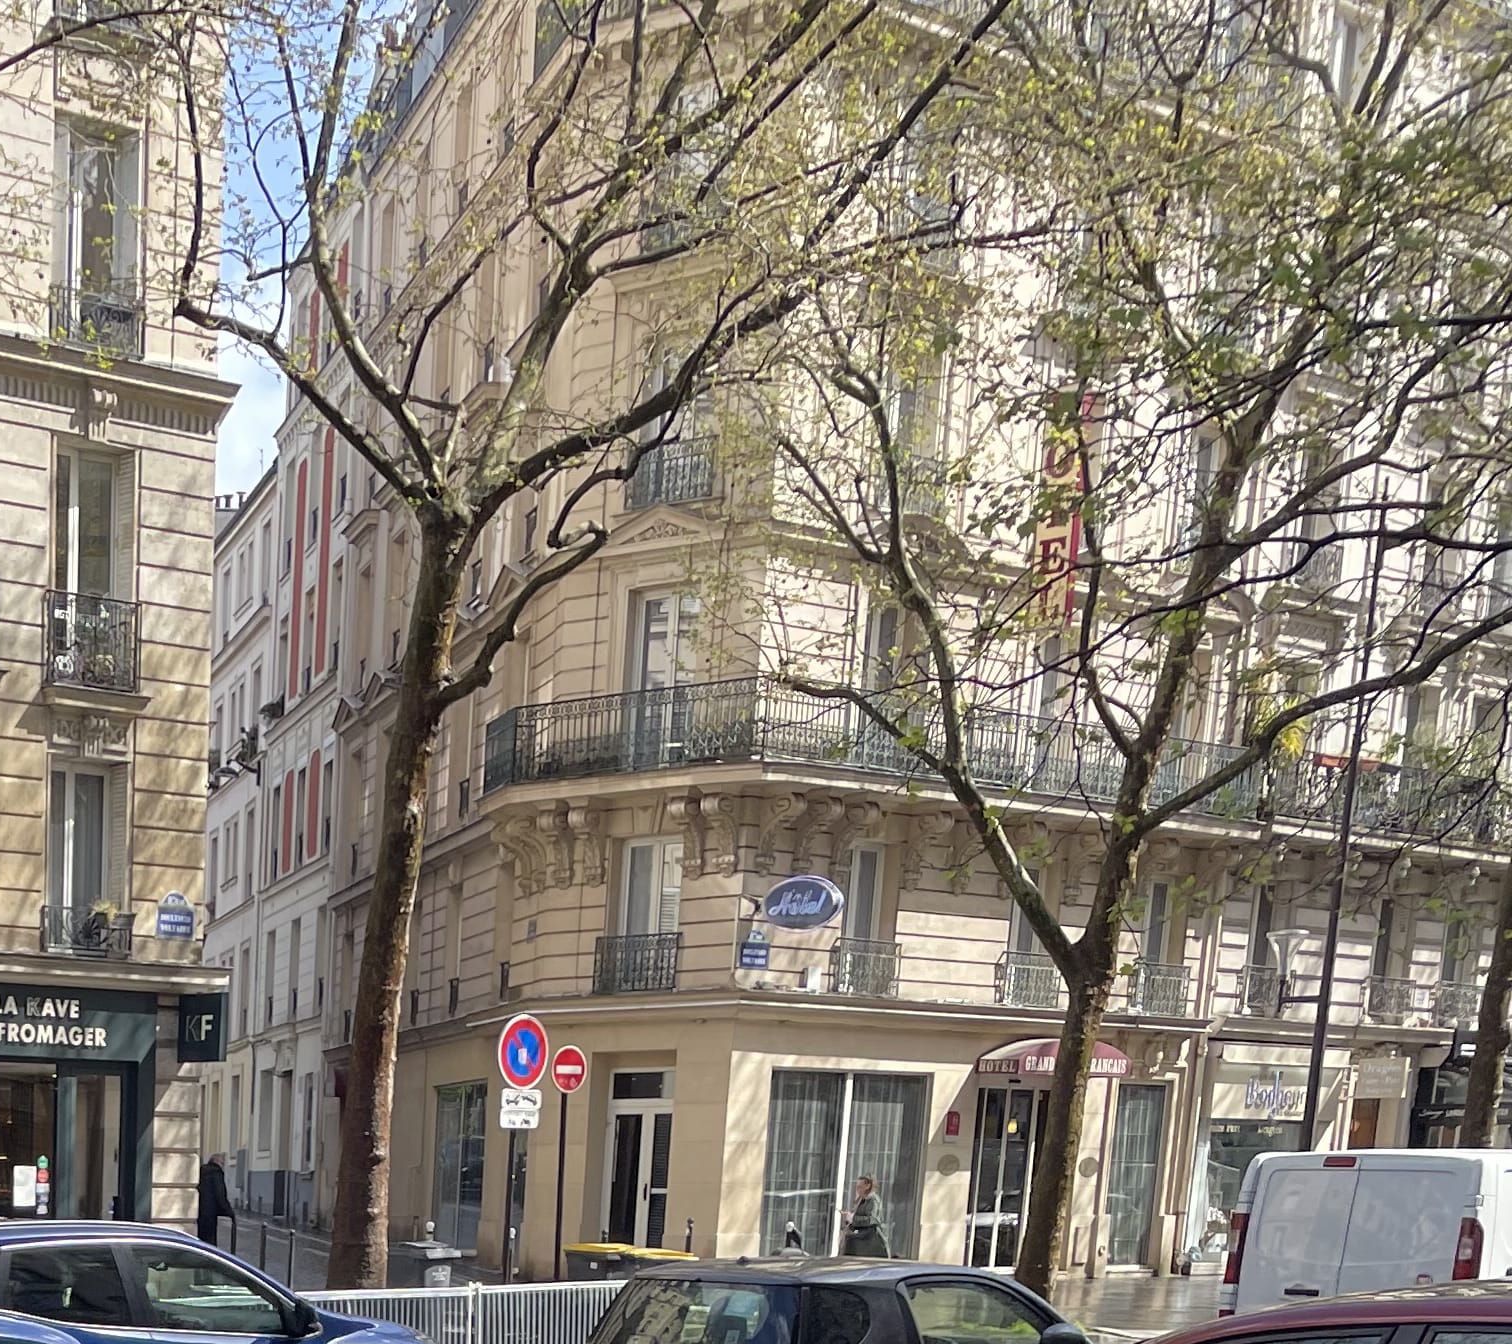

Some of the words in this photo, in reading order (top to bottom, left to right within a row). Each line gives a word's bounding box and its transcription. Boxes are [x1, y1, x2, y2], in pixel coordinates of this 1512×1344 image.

[26, 997, 80, 1019] KAVE
[185, 1014, 214, 1042] KF
[978, 1059, 1015, 1073] HOTEL
[1025, 1056, 1056, 1071] GRAND
[1089, 1058, 1127, 1074] RANCAIS
